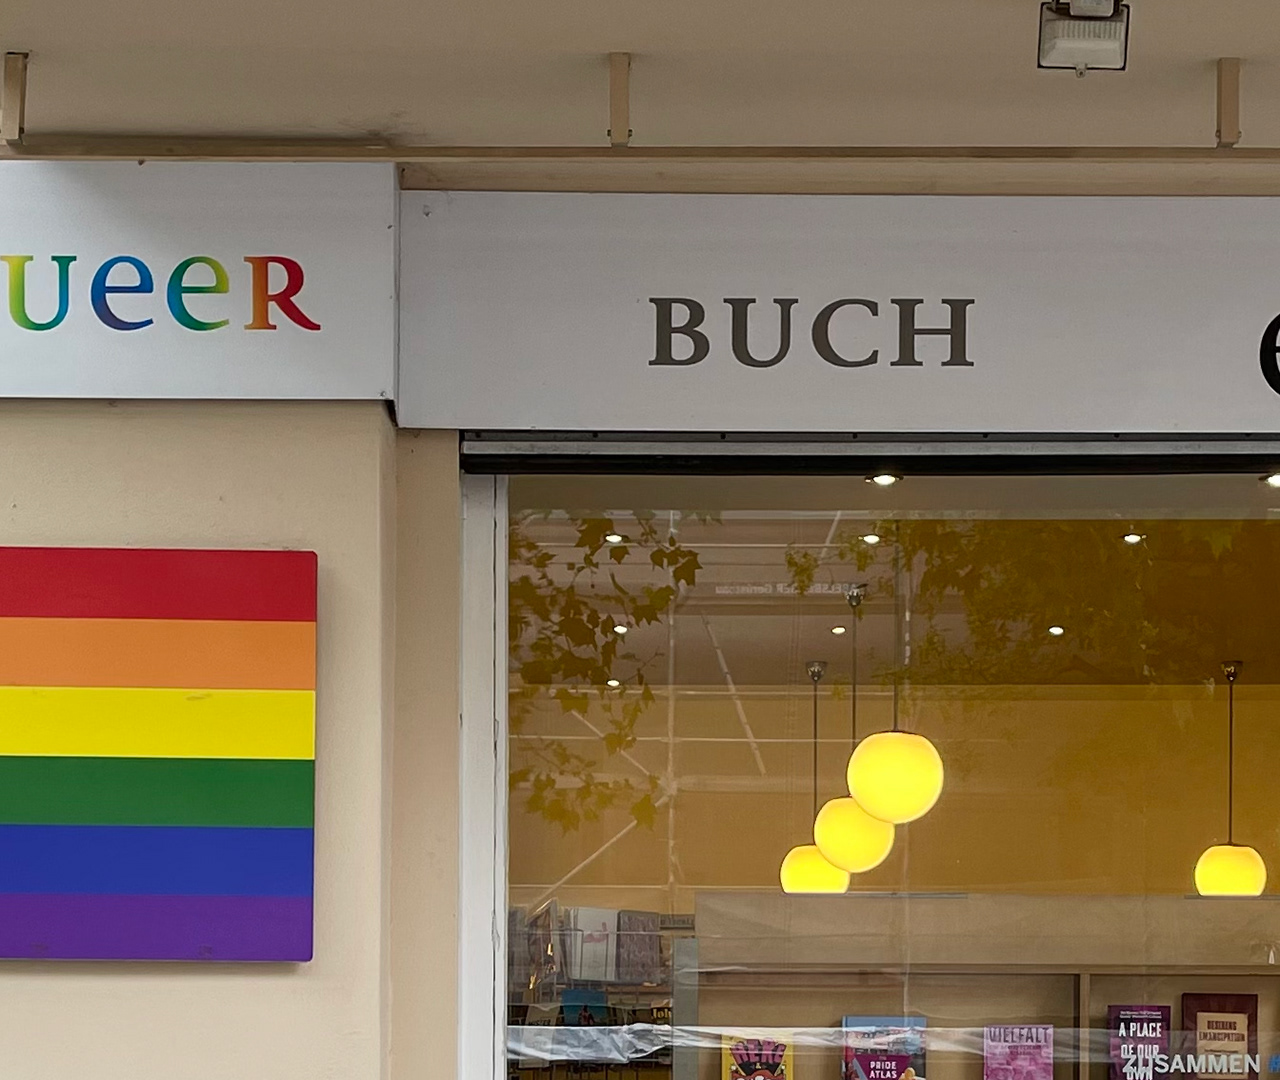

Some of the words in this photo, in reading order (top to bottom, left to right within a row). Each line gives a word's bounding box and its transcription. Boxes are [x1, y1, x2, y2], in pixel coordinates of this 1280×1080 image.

[649, 298, 975, 368] BUCH
[989, 1027, 1049, 1043] VIELFALT
[1119, 1022, 1126, 1037] A
[1130, 1022, 1162, 1037] PLACE
[870, 1061, 897, 1070] PRIDE
[1122, 1054, 1261, 1073] ZUSAMMEN
[869, 1070, 897, 1079] ATLAS
